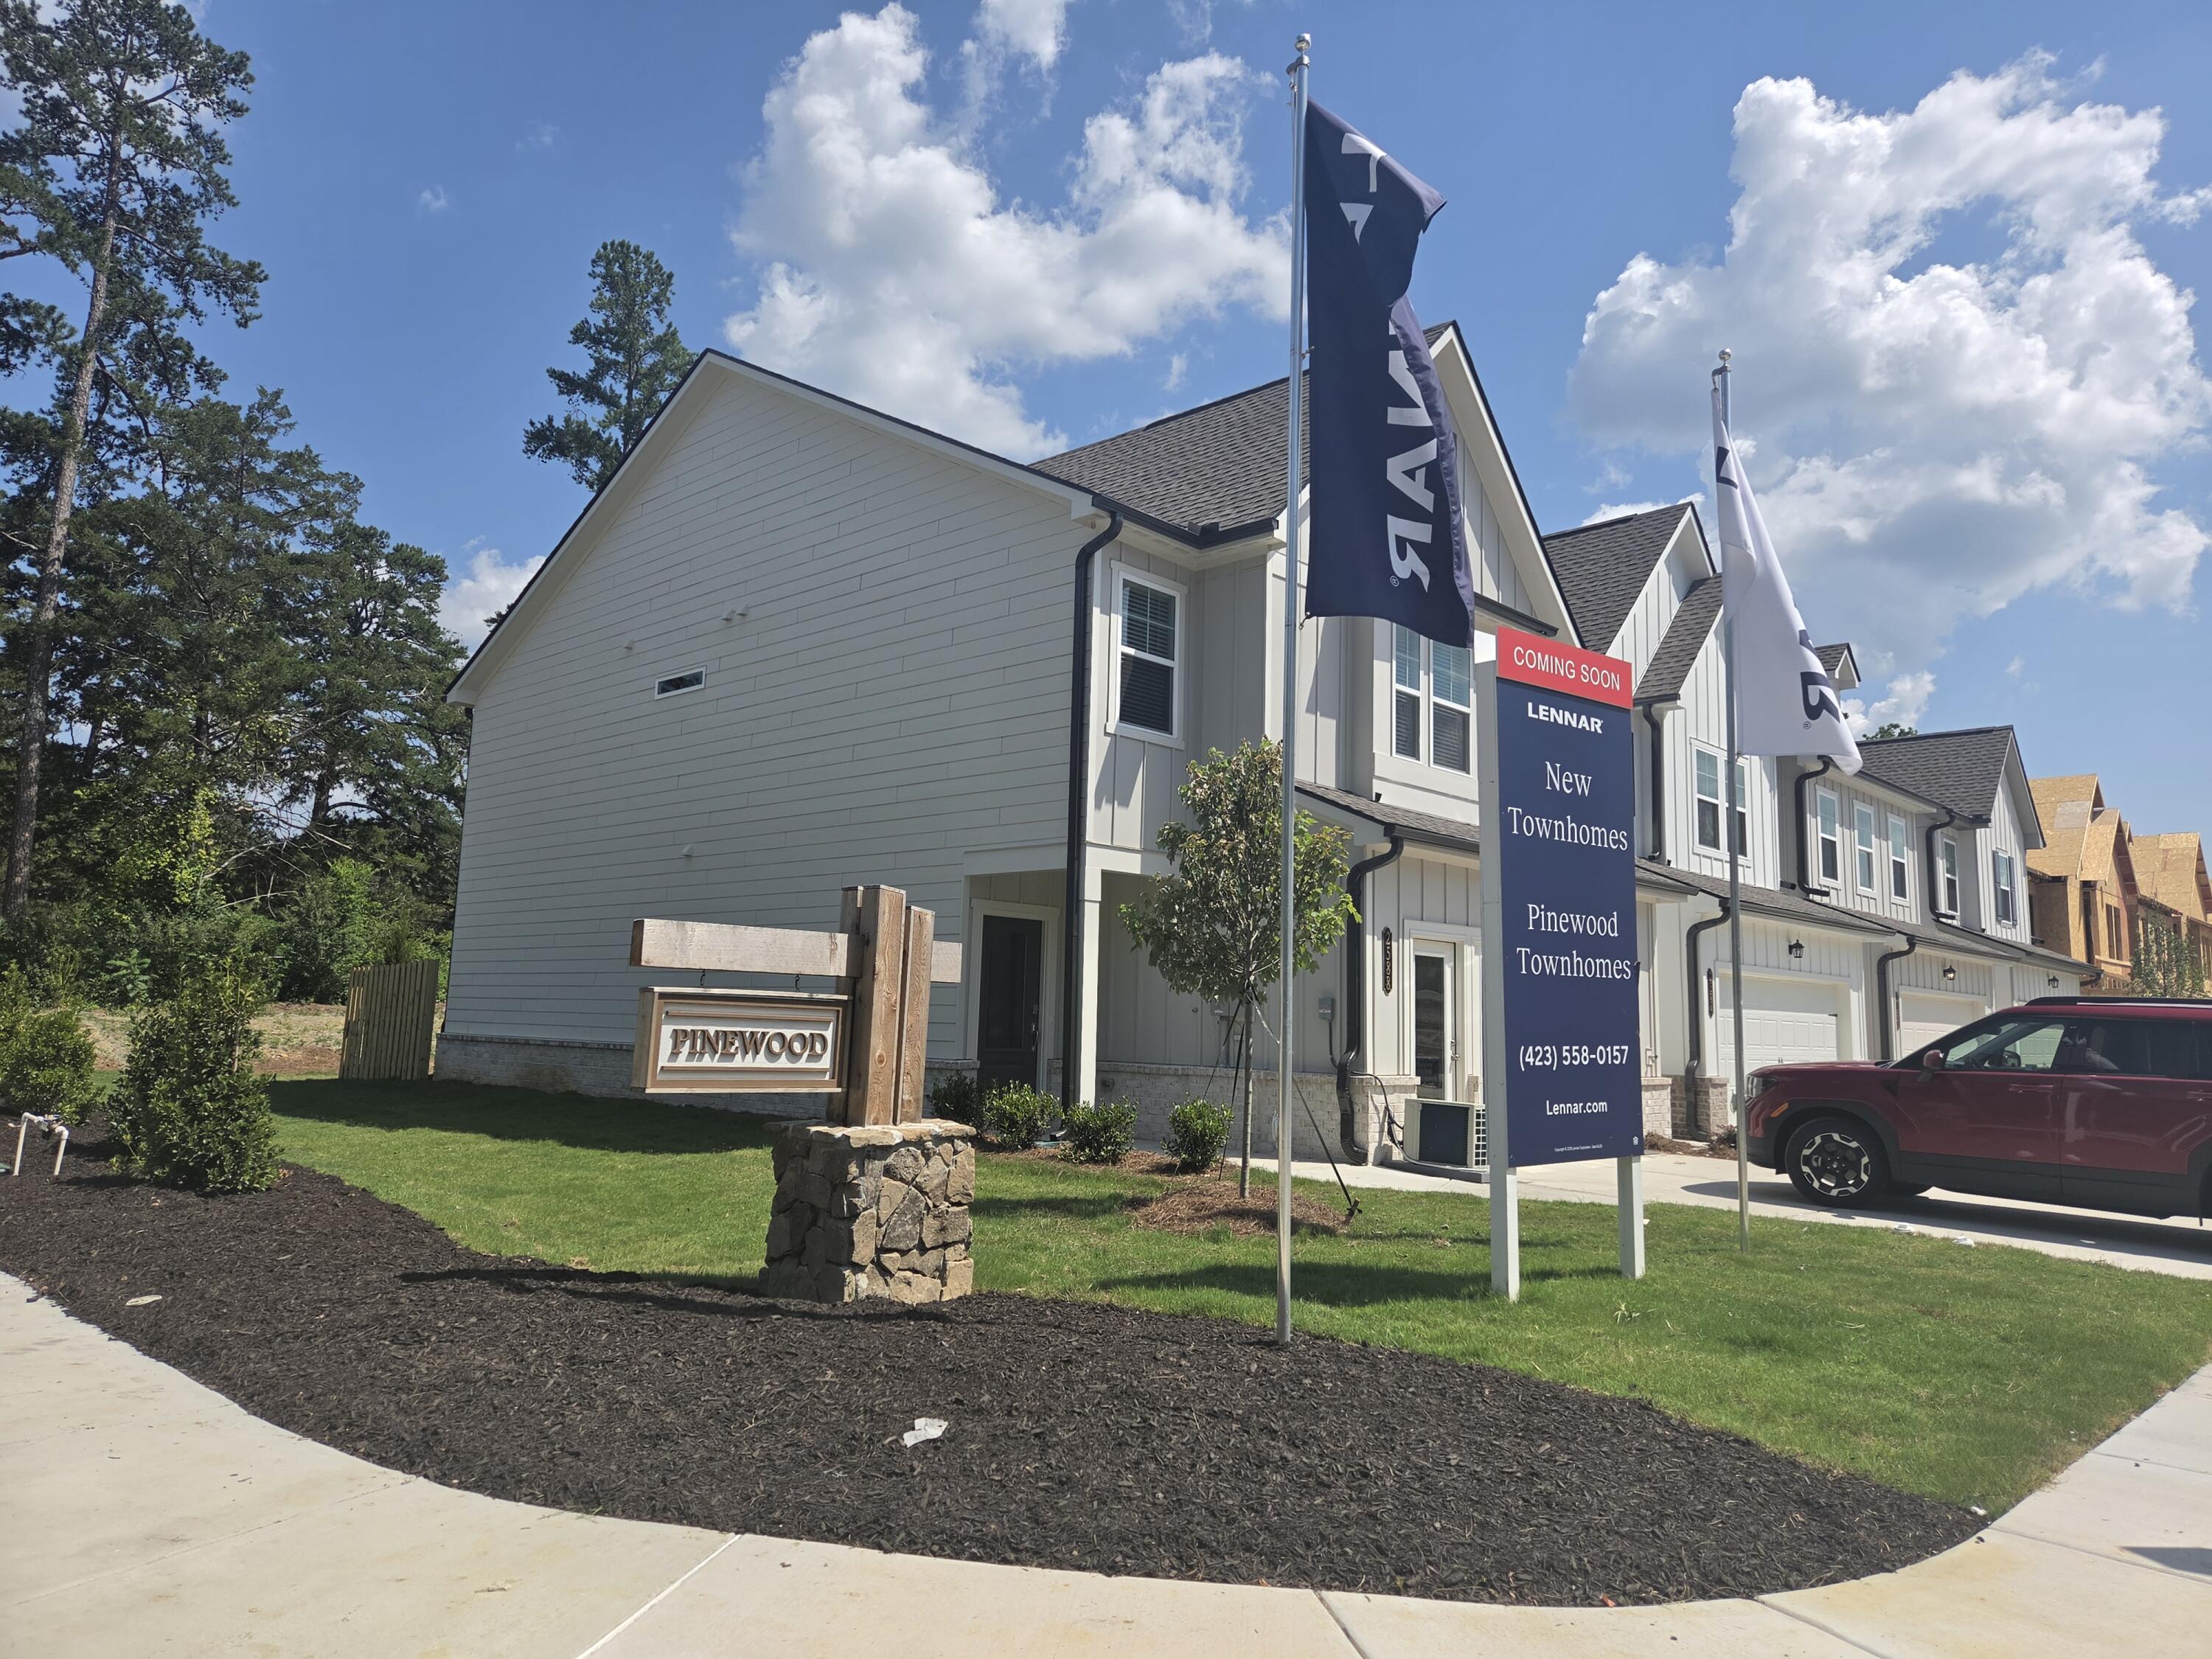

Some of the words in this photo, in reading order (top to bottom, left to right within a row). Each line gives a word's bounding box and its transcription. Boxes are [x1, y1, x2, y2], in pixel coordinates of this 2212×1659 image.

[1514, 646, 1575, 678] COMING
[1580, 664, 1620, 691] SOON
[1528, 702, 1602, 734] LENNAR
[1545, 761, 1592, 796] New
[1507, 806, 1628, 850] Townhomes
[1527, 904, 1618, 937] Pinewood
[1516, 947, 1632, 979] Townhomes
[670, 1029, 828, 1057] PINEWOOD
[1519, 1046, 1558, 1071] (423)
[1562, 1045, 1629, 1065] 558-0157
[1546, 1100, 1607, 1115] Lennar.com
